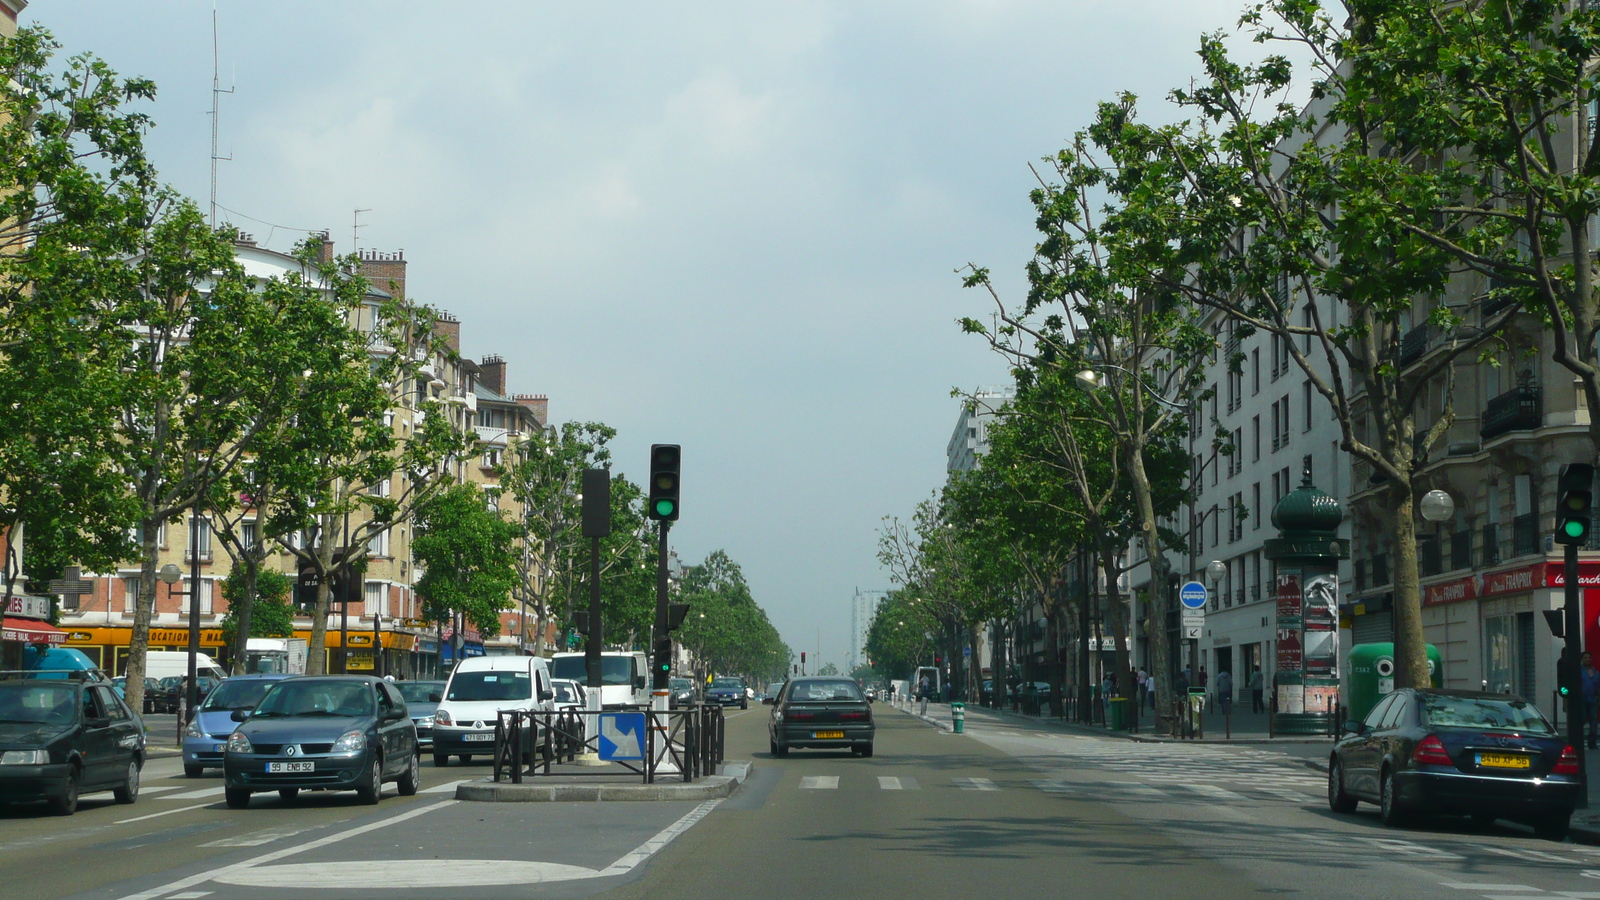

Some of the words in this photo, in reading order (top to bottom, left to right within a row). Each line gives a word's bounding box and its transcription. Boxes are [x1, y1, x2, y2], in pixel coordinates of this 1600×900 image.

[1505, 571, 1533, 590] FRANPRIX
[1577, 573, 1600, 584] arch
[1502, 755, 1514, 764] XP
[271, 763, 281, 771] 99
